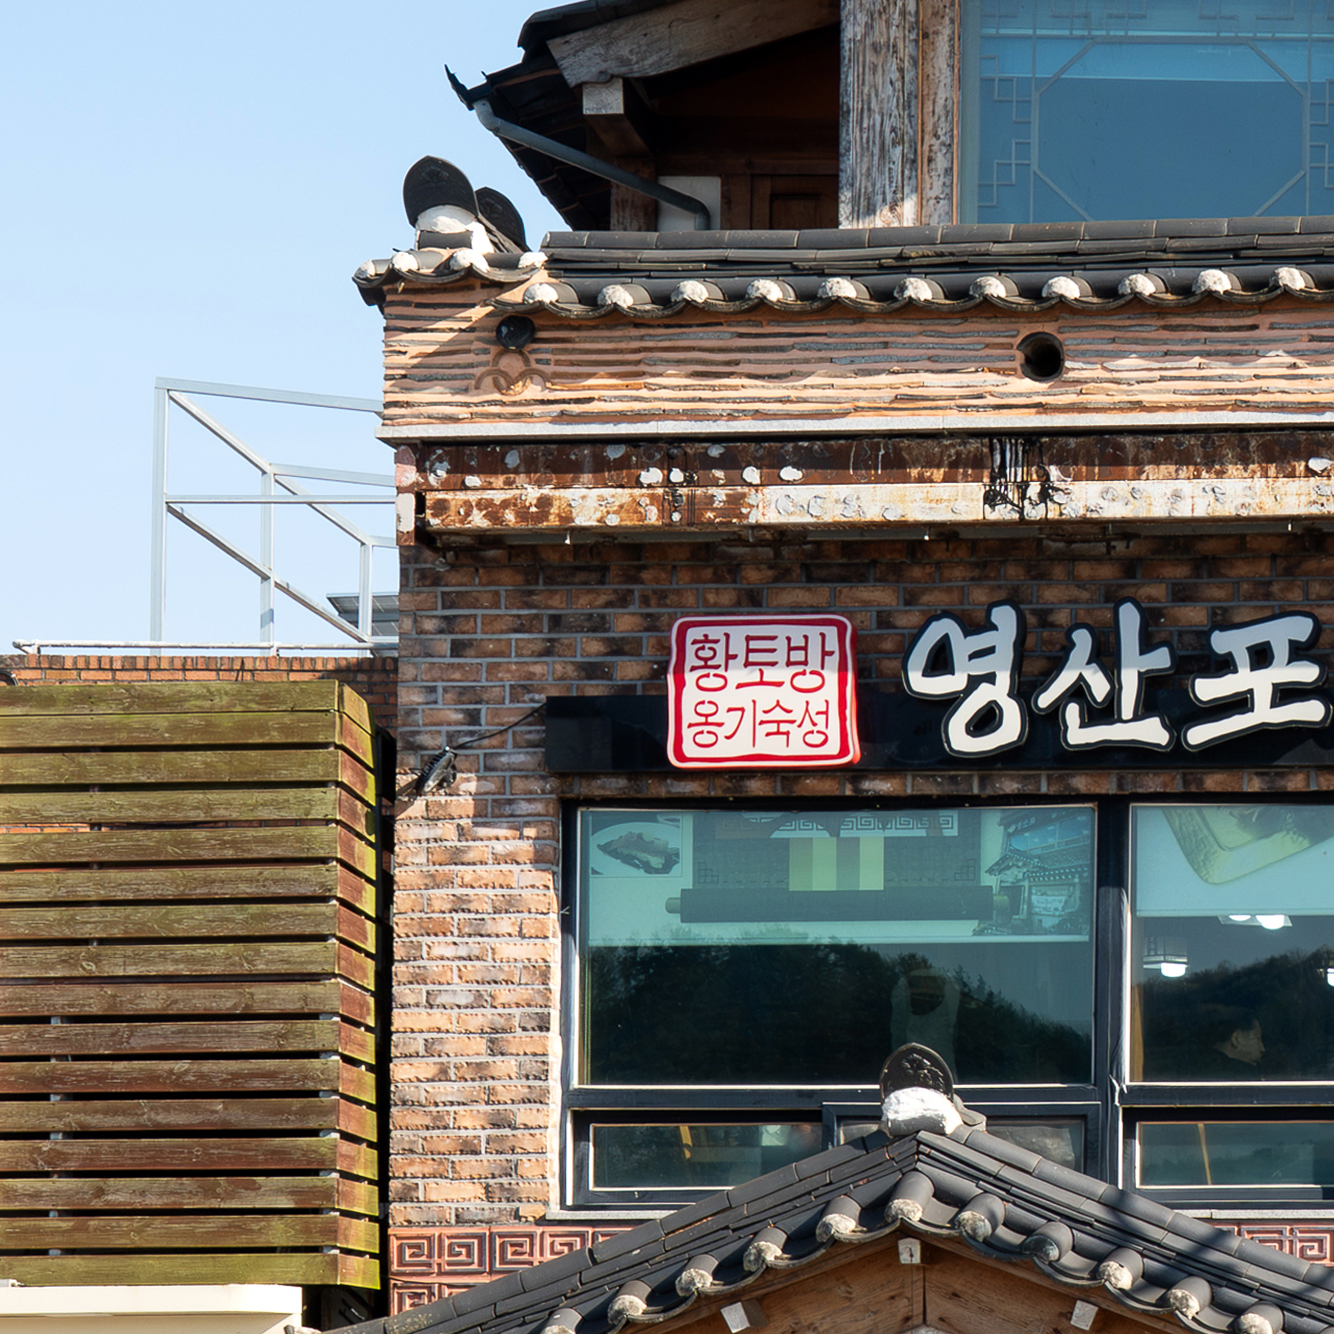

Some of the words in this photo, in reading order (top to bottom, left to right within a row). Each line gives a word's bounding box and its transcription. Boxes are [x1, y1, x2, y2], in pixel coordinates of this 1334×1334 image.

[689, 631, 836, 694] 황토방
[905, 598, 1331, 754] 영산포
[686, 699, 830, 749] 옹기숙성
